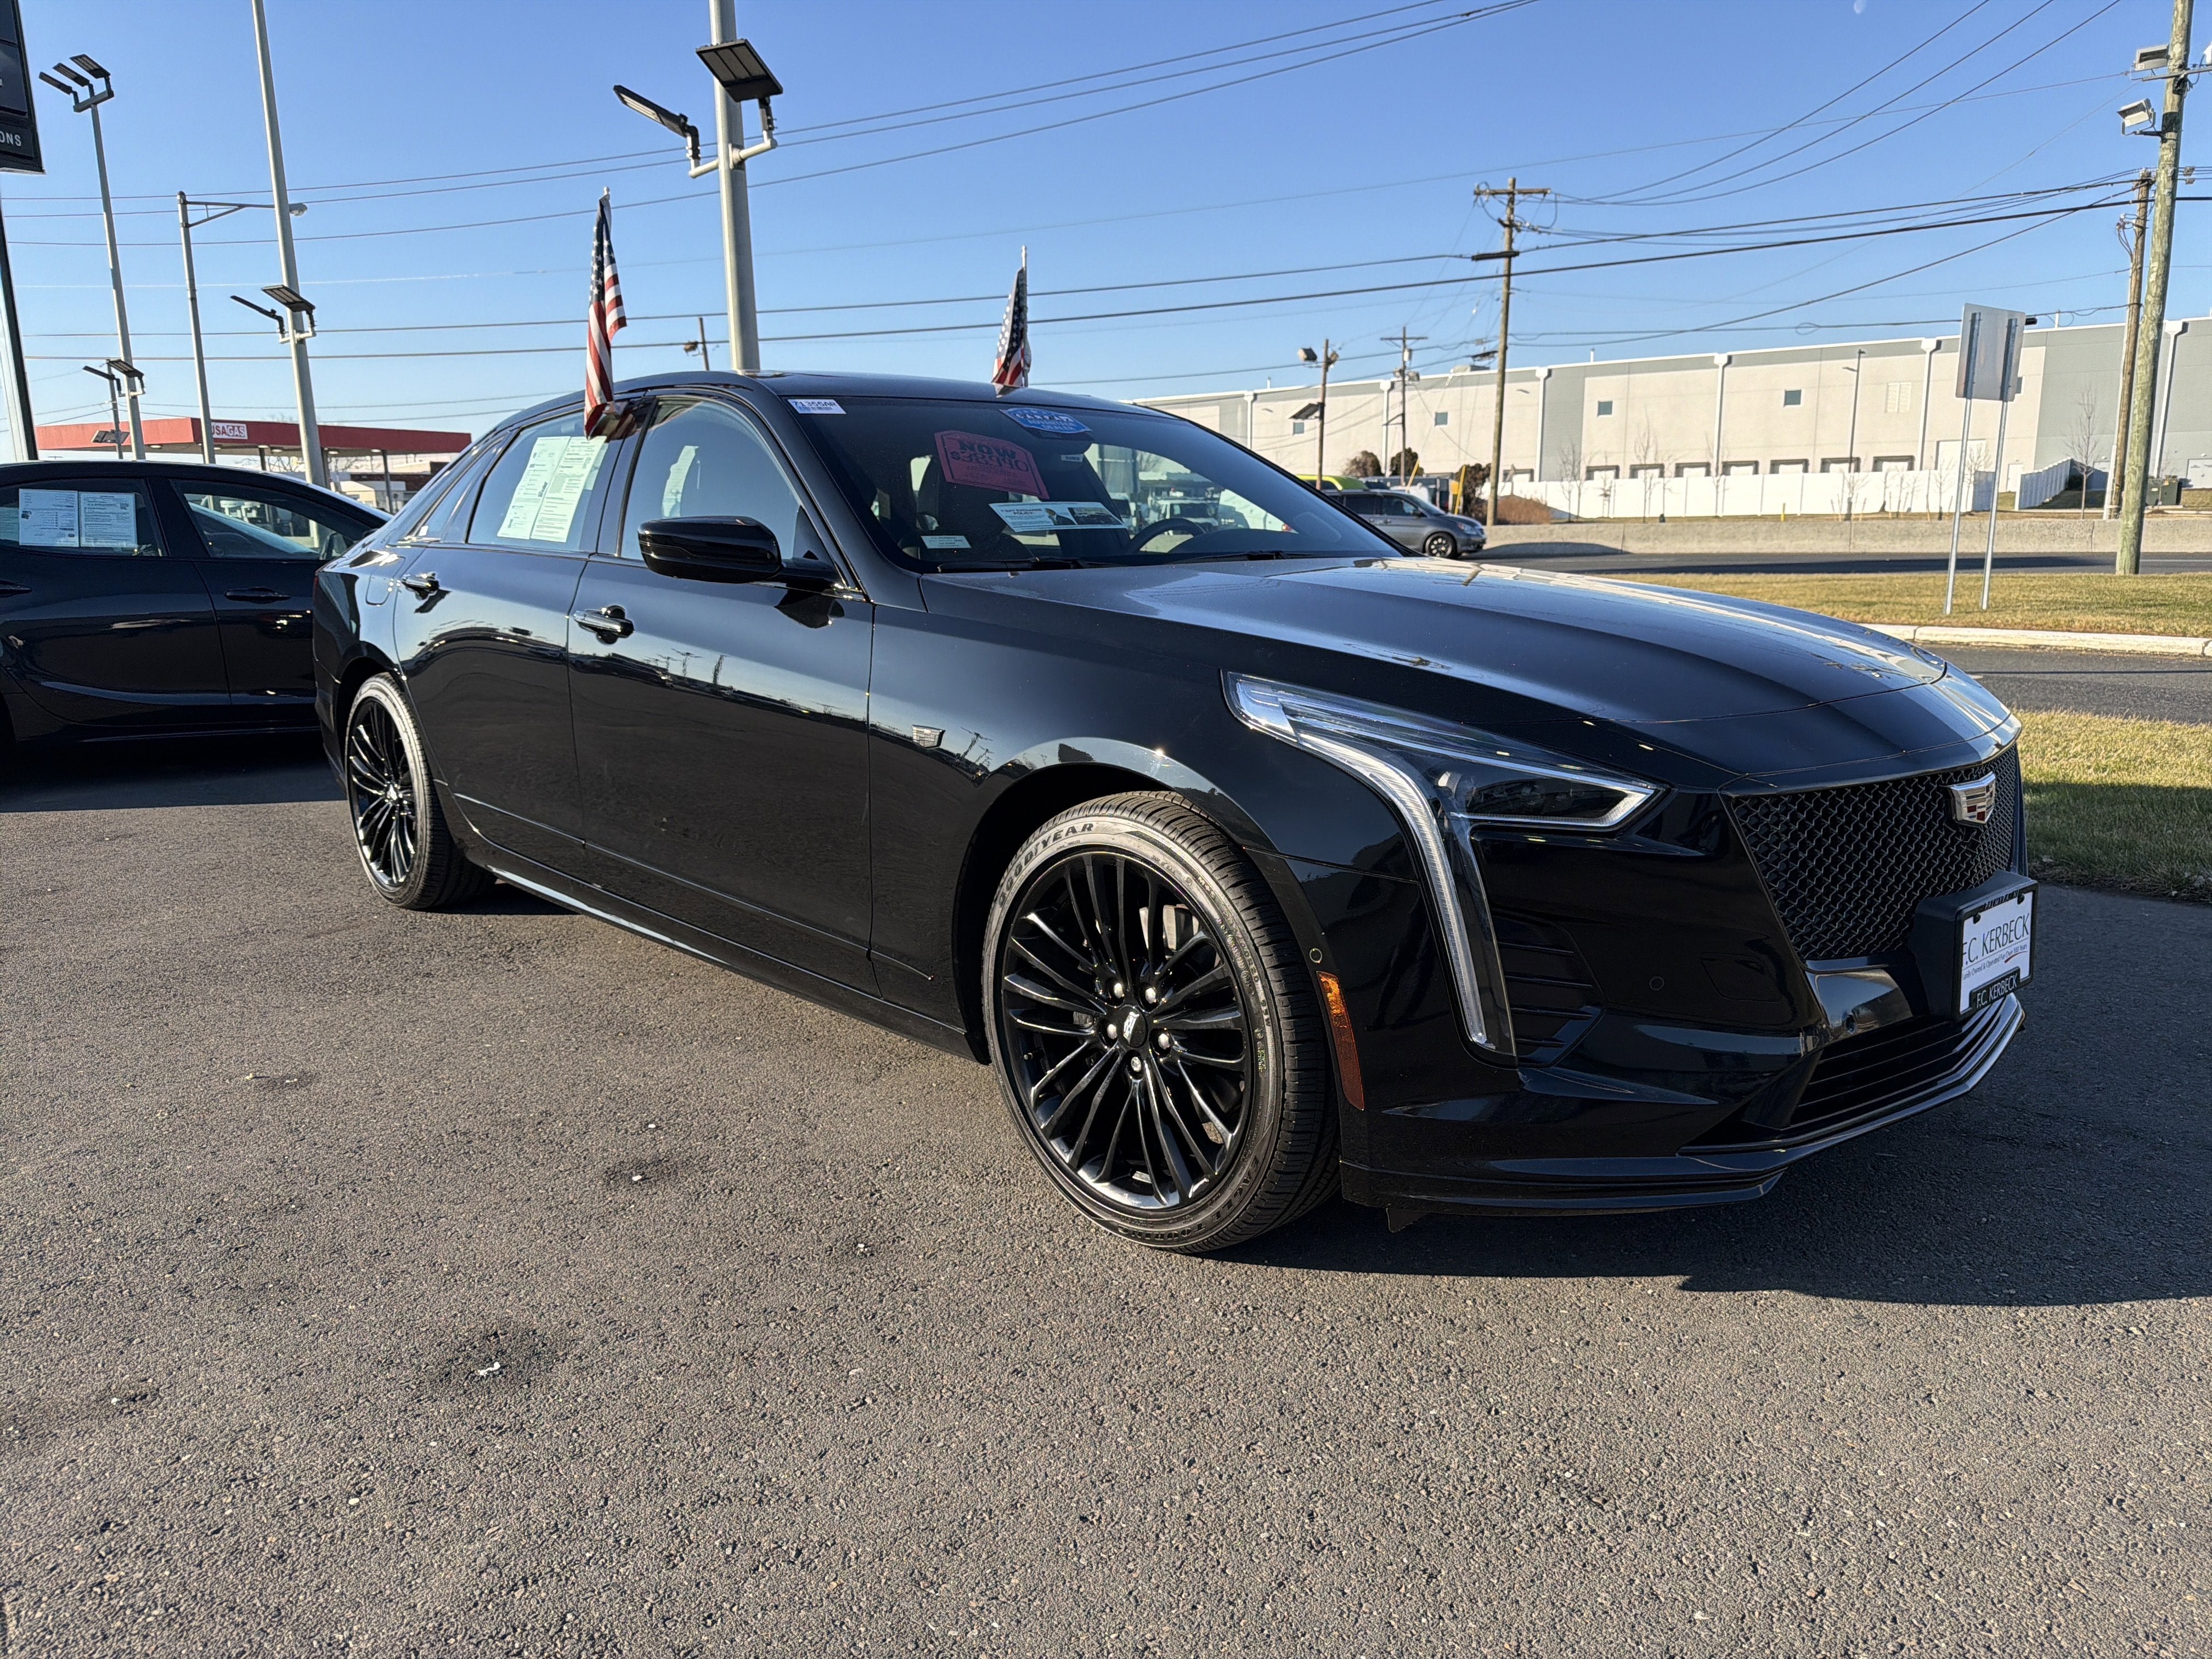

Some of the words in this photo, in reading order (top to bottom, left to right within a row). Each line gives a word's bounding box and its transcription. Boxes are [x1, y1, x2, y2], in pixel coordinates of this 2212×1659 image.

[959, 441, 1017, 459] NOW
[998, 823, 1094, 908] GOODYEAR
[1982, 912, 2030, 957] KERBECK
[1976, 990, 1987, 1008] F.C.
[1989, 973, 2018, 1002] KERBECK
